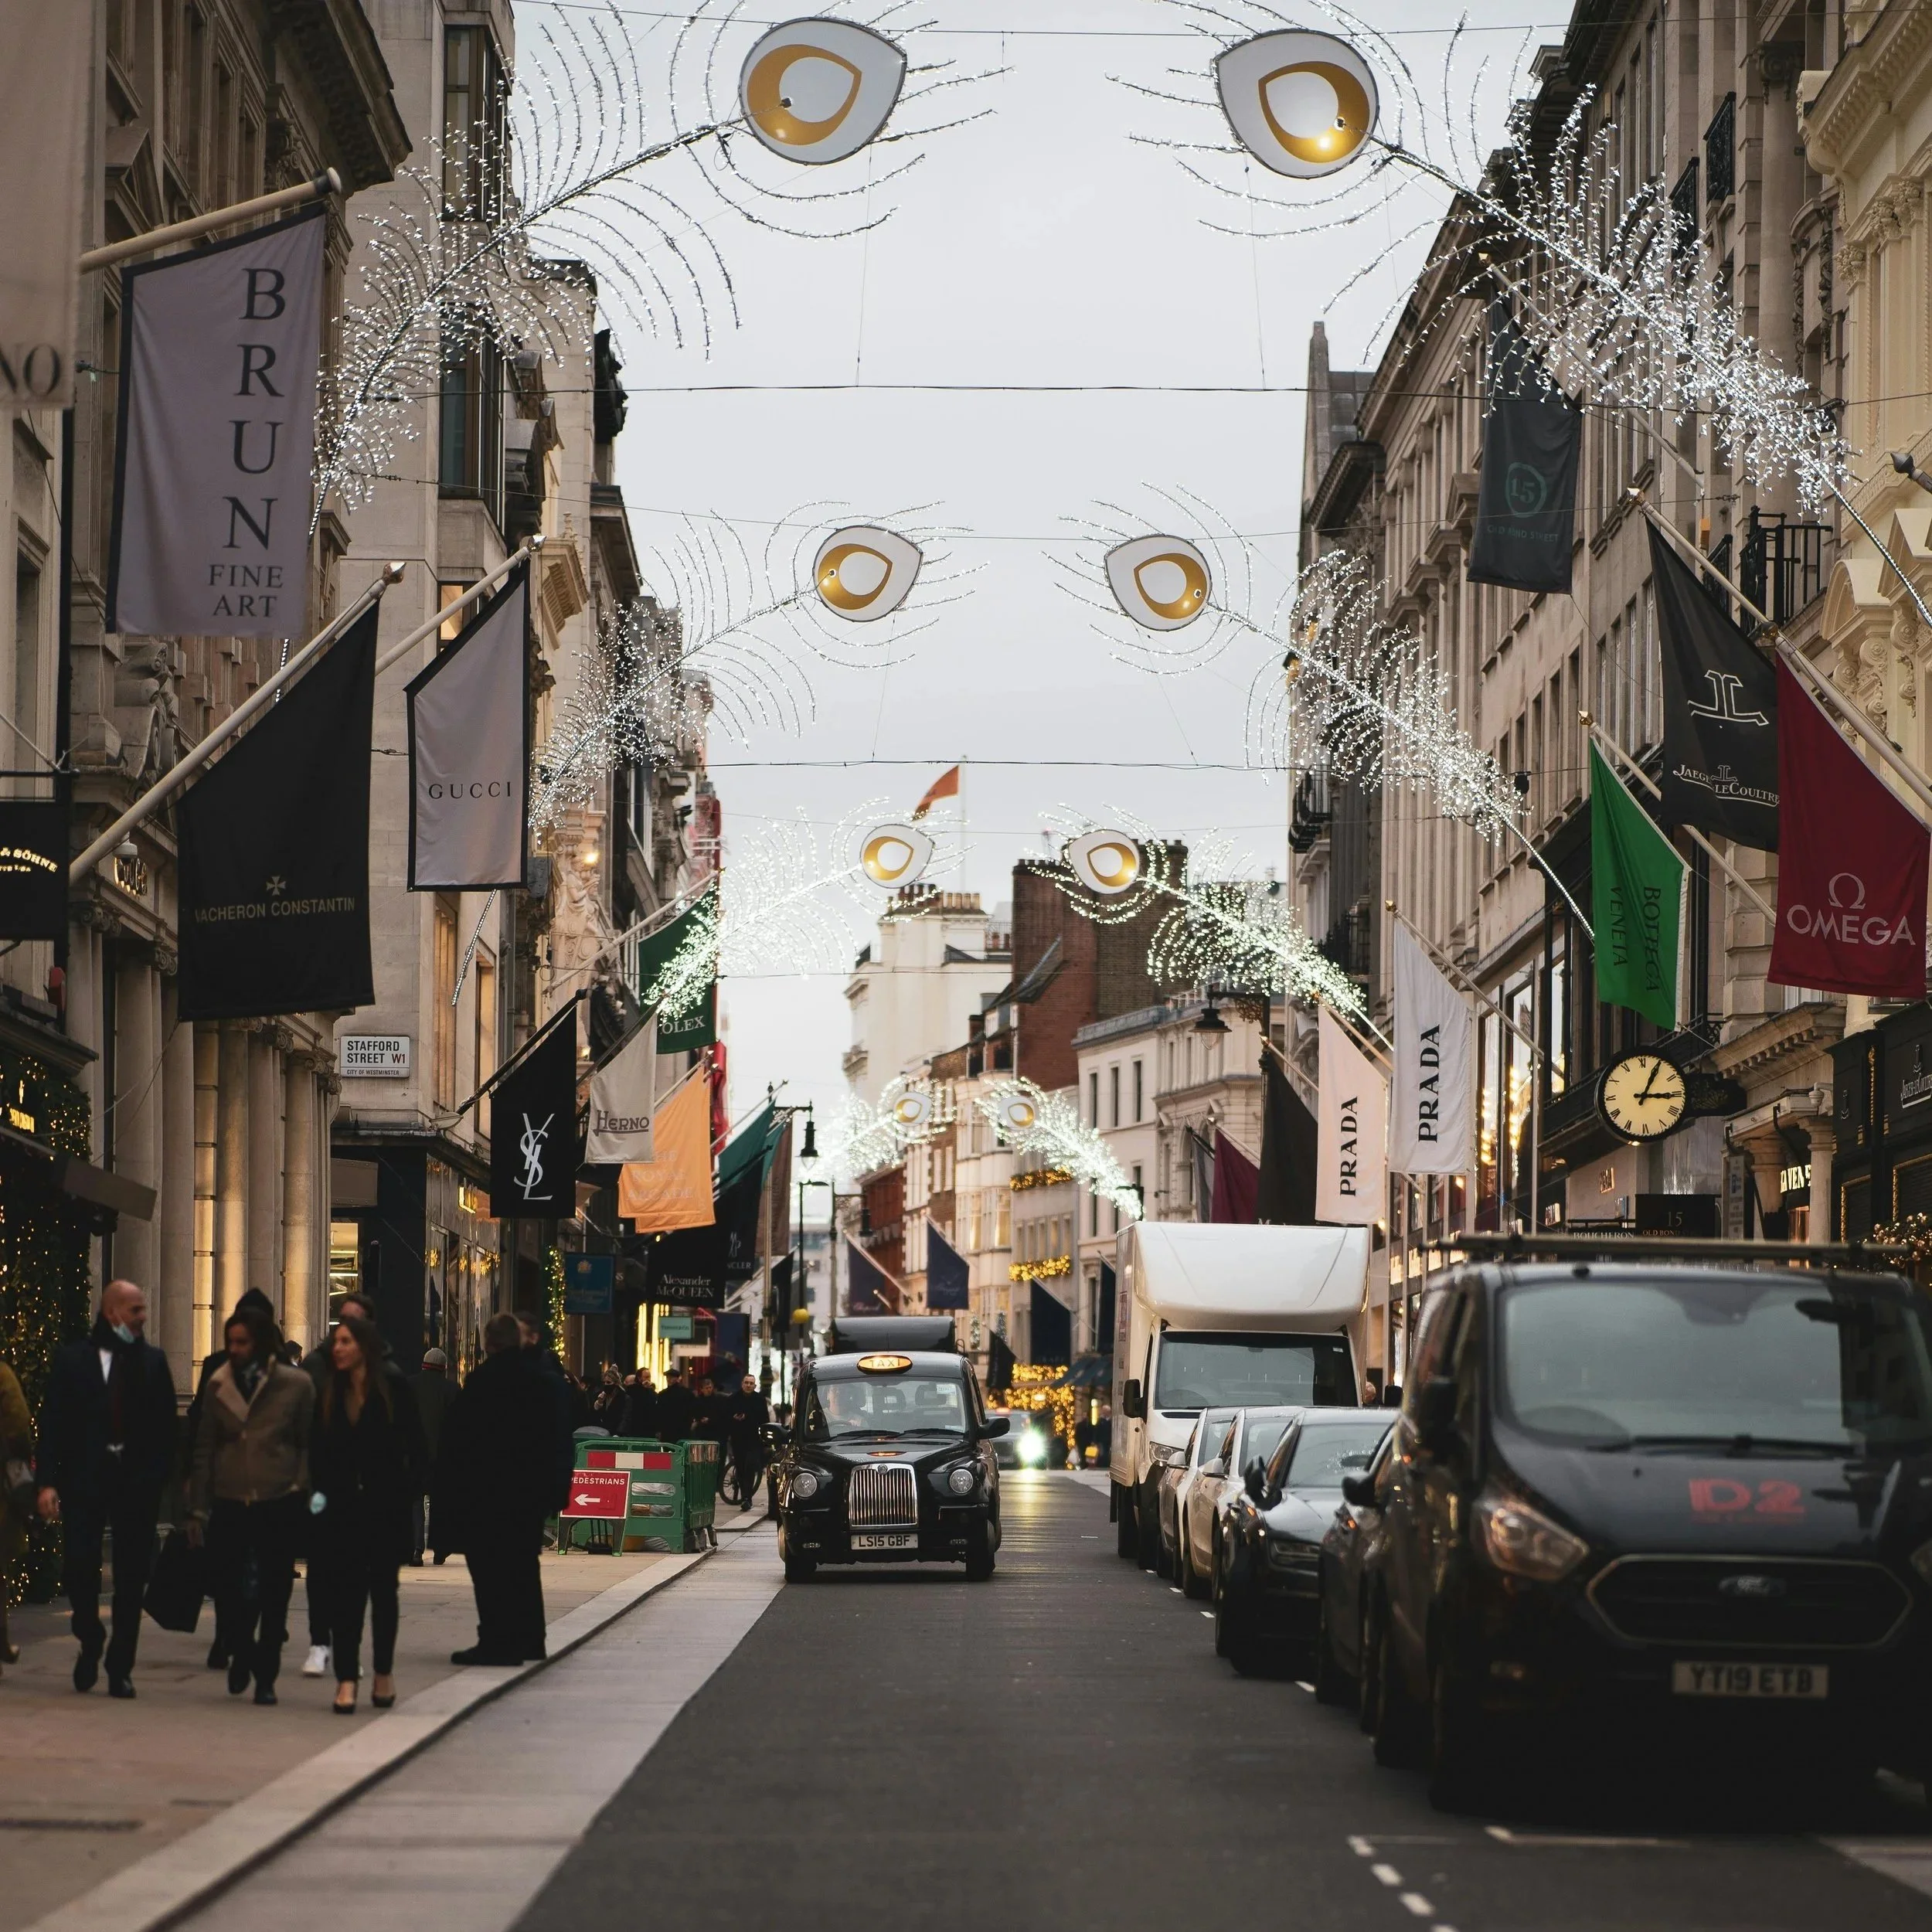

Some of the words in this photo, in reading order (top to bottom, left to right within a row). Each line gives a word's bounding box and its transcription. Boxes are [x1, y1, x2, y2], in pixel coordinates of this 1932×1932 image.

[222, 267, 287, 552] BRUN
[1511, 478, 1536, 504] 15
[209, 563, 284, 589] FINE
[213, 594, 278, 618] ART
[429, 781, 511, 799] GUCCI
[271, 896, 355, 917] CONSTANTIN
[1787, 904, 1917, 946] OMEGA
[659, 1015, 706, 1035] OLEX
[347, 1040, 400, 1052] STAFFORD
[347, 1053, 385, 1063] STREET
[391, 1053, 406, 1064] W1
[1418, 1024, 1440, 1143] PRADA
[597, 1110, 650, 1132] HERNO
[1340, 1096, 1358, 1198] PRADA
[1667, 1211, 1683, 1227] 15
[661, 1274, 712, 1286] Alexander
[655, 1285, 715, 1299] McQUEEN
[869, 1359, 900, 1368] TAXI
[571, 1477, 625, 1485] EDESTRIANS
[1688, 1478, 1805, 1513] D2
[859, 1536, 885, 1547] LS15
[887, 1535, 910, 1546] GBF
[1692, 1666, 1751, 1692] YT19
